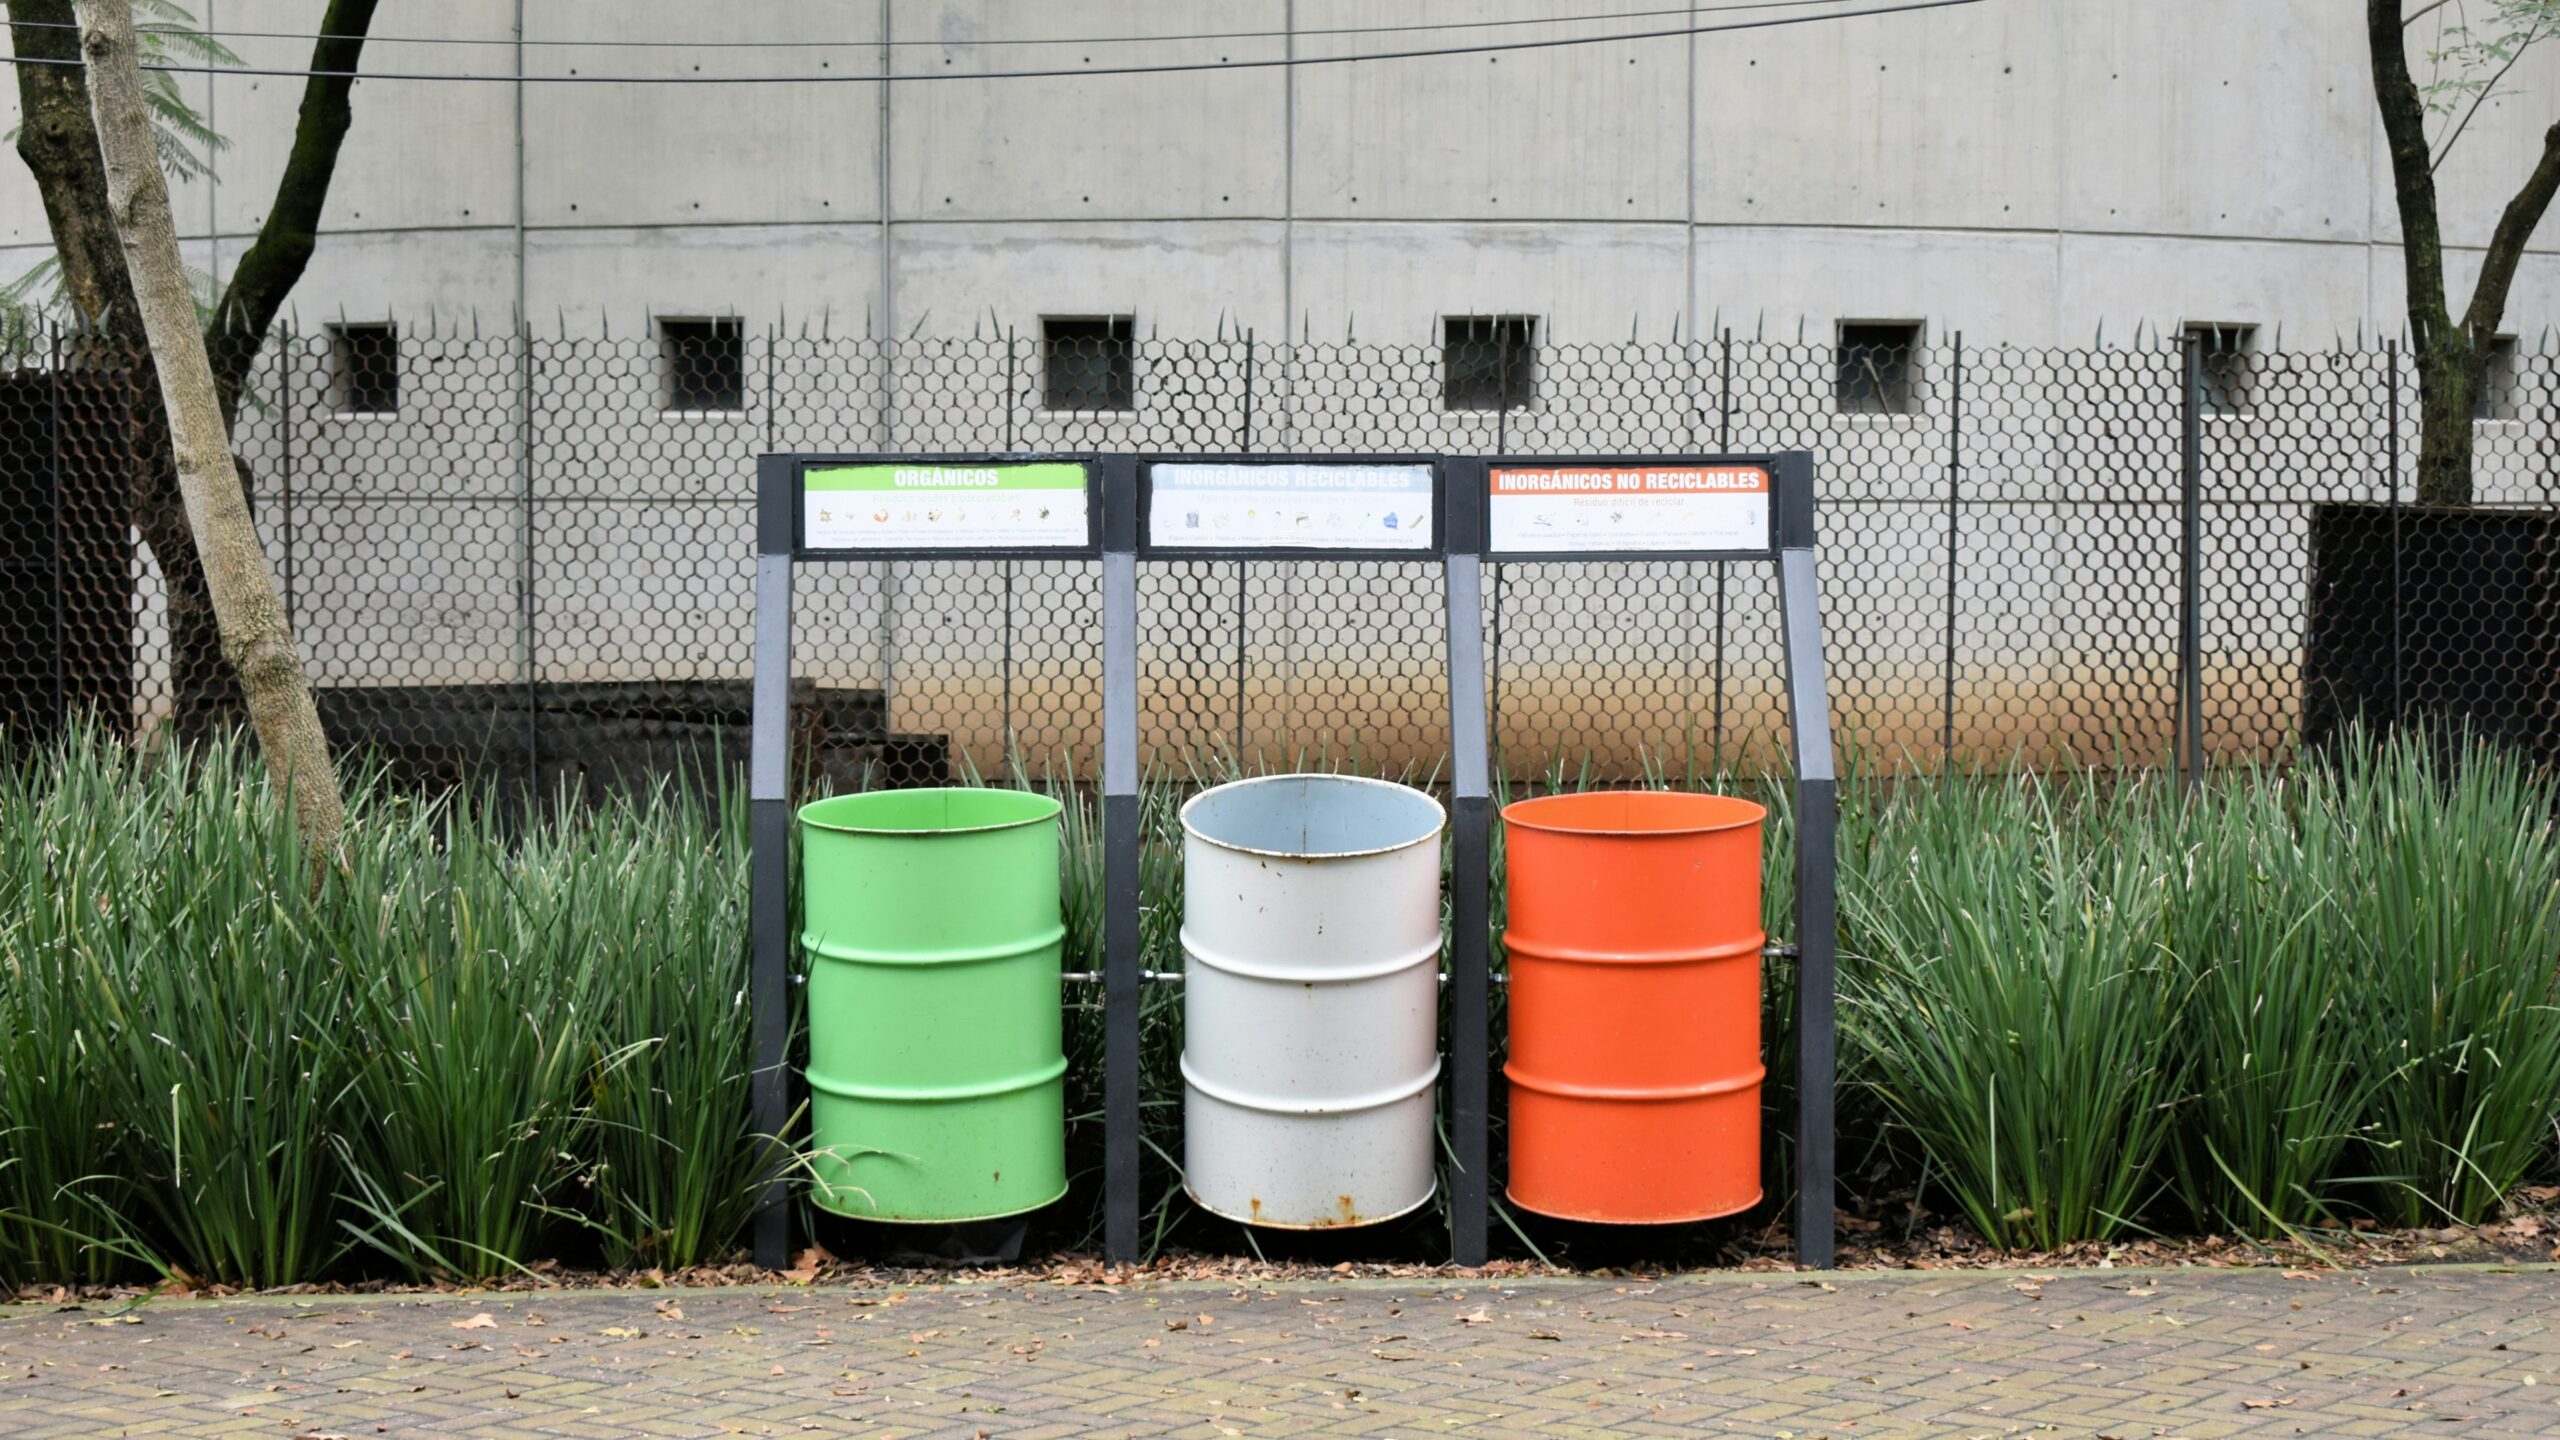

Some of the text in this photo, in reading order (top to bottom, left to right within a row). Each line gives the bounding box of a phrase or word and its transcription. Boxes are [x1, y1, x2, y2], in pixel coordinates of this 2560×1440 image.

[894, 467, 998, 487] ORGÁNICOS
[1174, 467, 1410, 488] INORGÁNICOS RECICLABLES
[1498, 470, 1760, 490] INORGÁNICOS NO RECICLABLES
[1573, 497, 1608, 507] Residuo
[1639, 497, 1649, 506] de
[1652, 496, 1685, 506] reciclar
